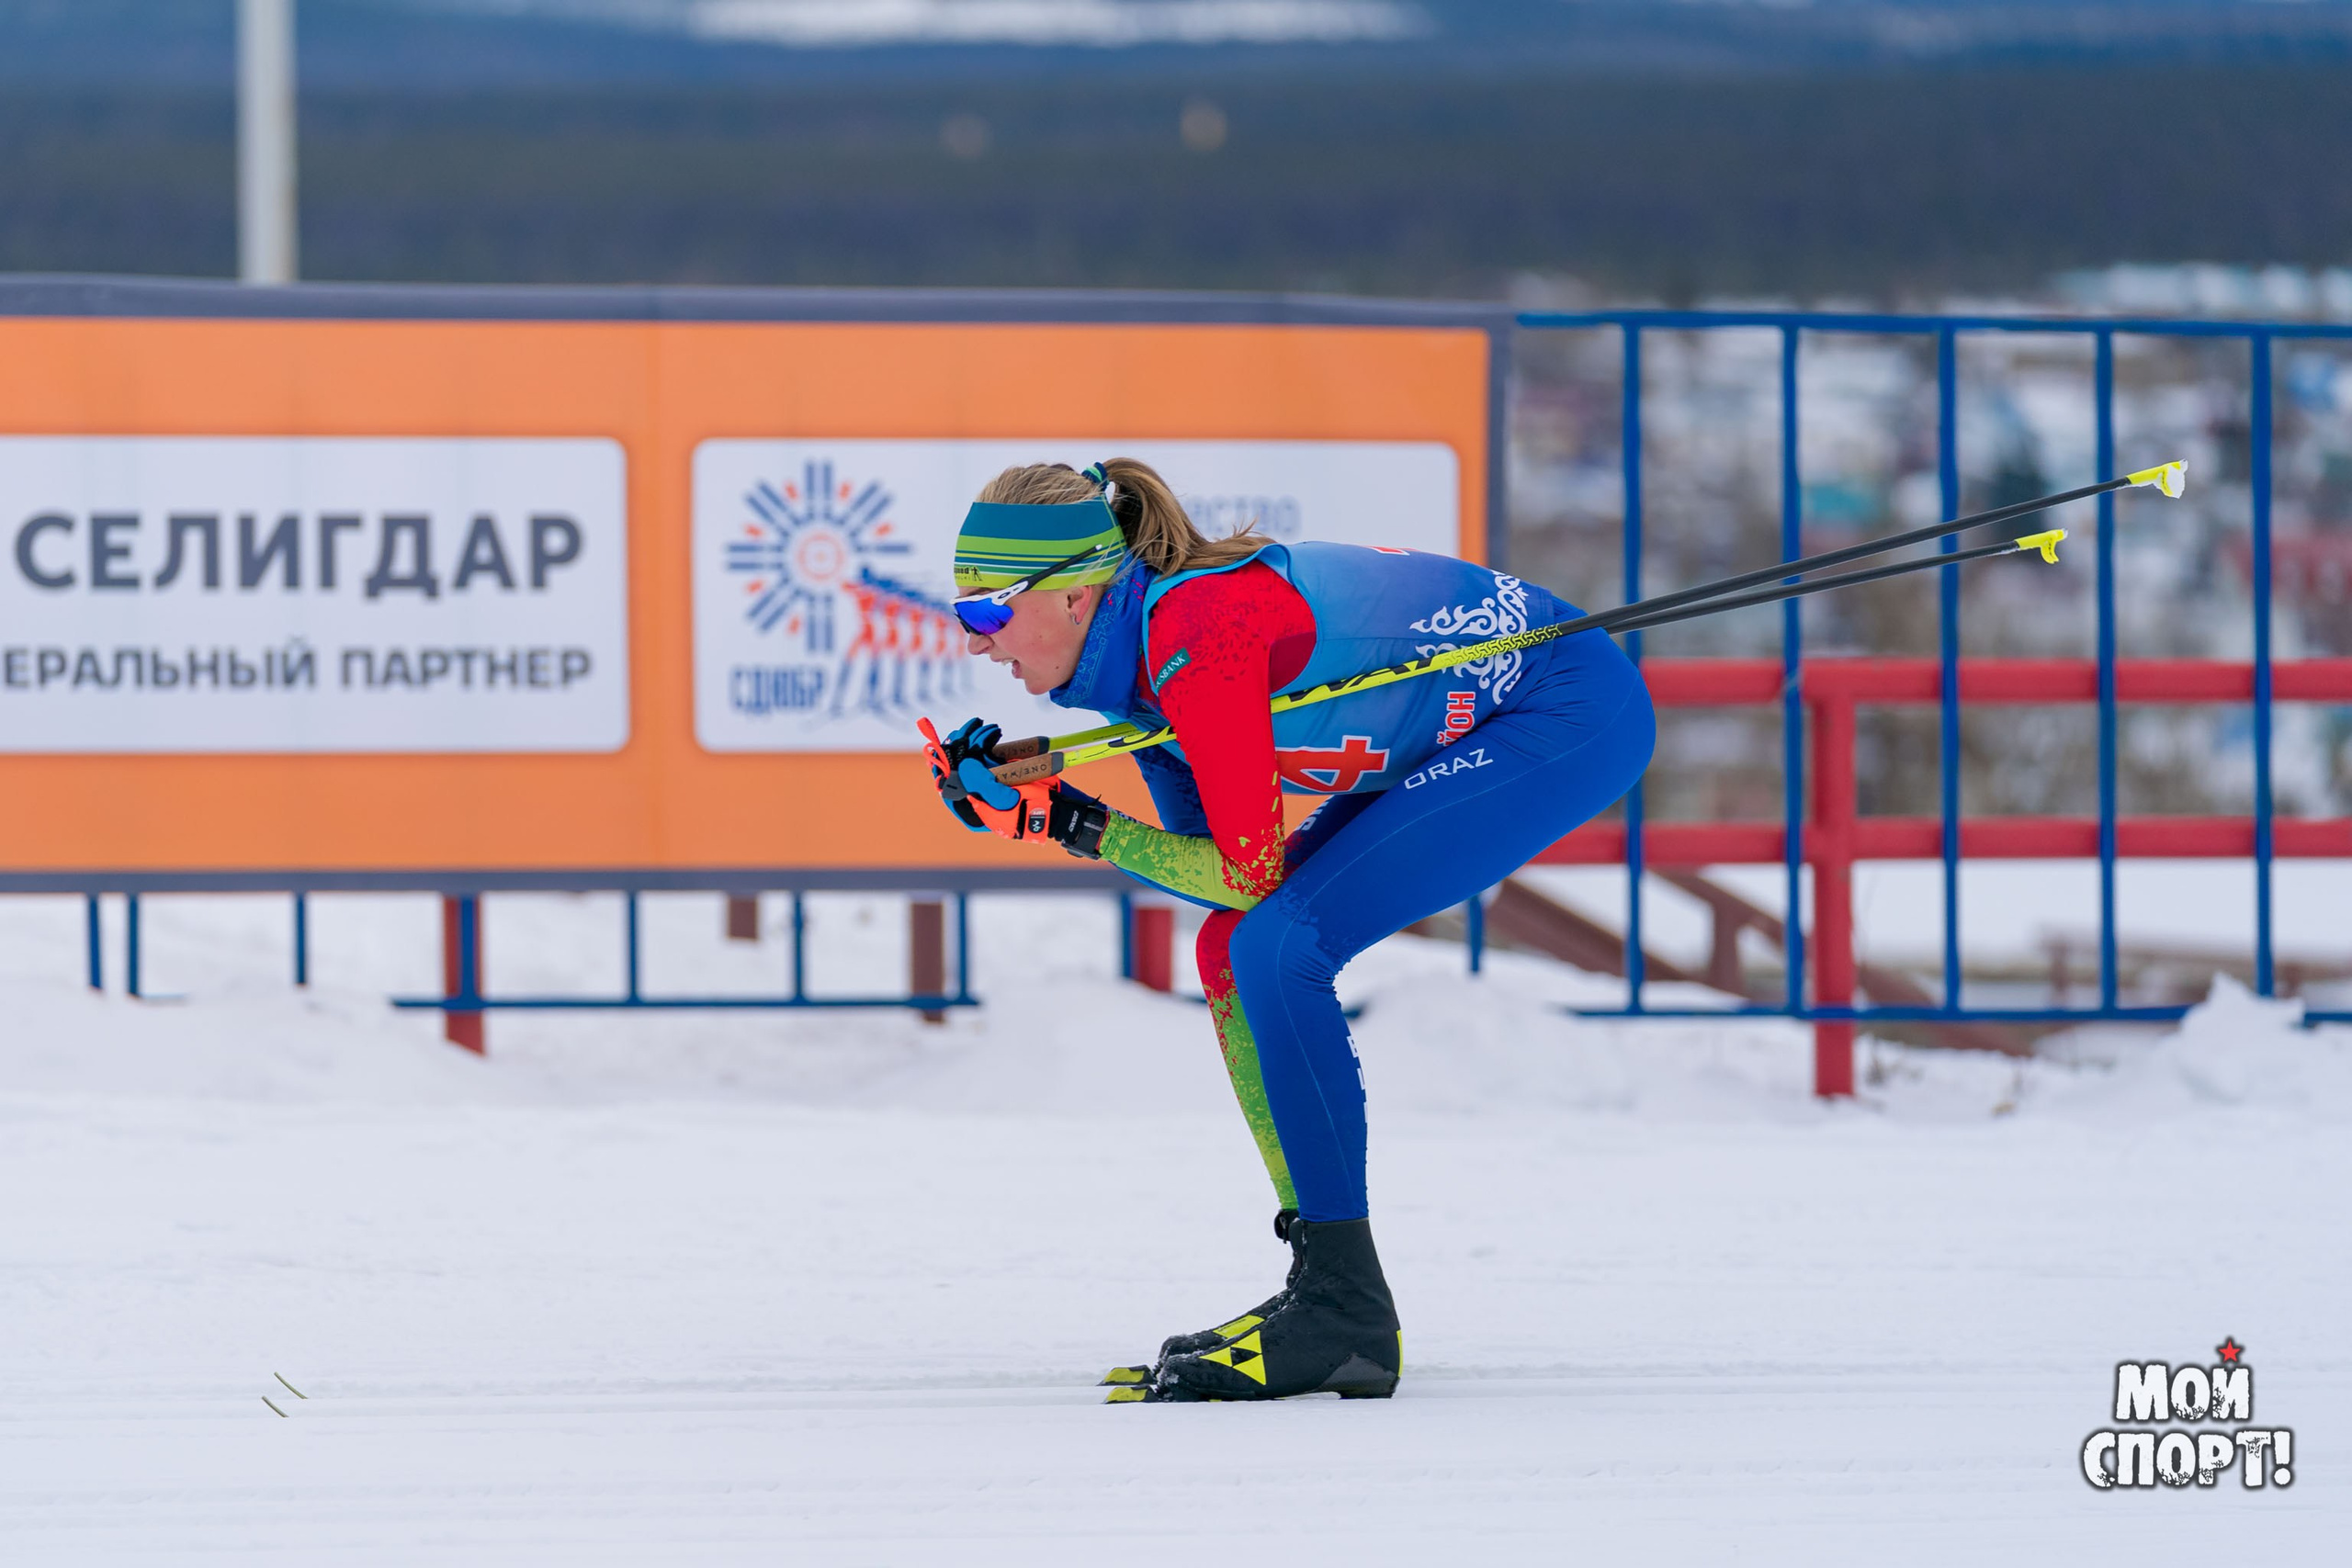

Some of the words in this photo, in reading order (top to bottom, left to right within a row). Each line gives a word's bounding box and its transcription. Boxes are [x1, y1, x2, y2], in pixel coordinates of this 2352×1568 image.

[14, 511, 584, 601] СЕЛИГДАР
[4, 637, 318, 690] ЕРАЛЬНЫЙ
[341, 649, 592, 690] ПАРТНЕР
[1000, 763, 1047, 780] ONE/WA
[1404, 748, 1494, 790] ORAZ
